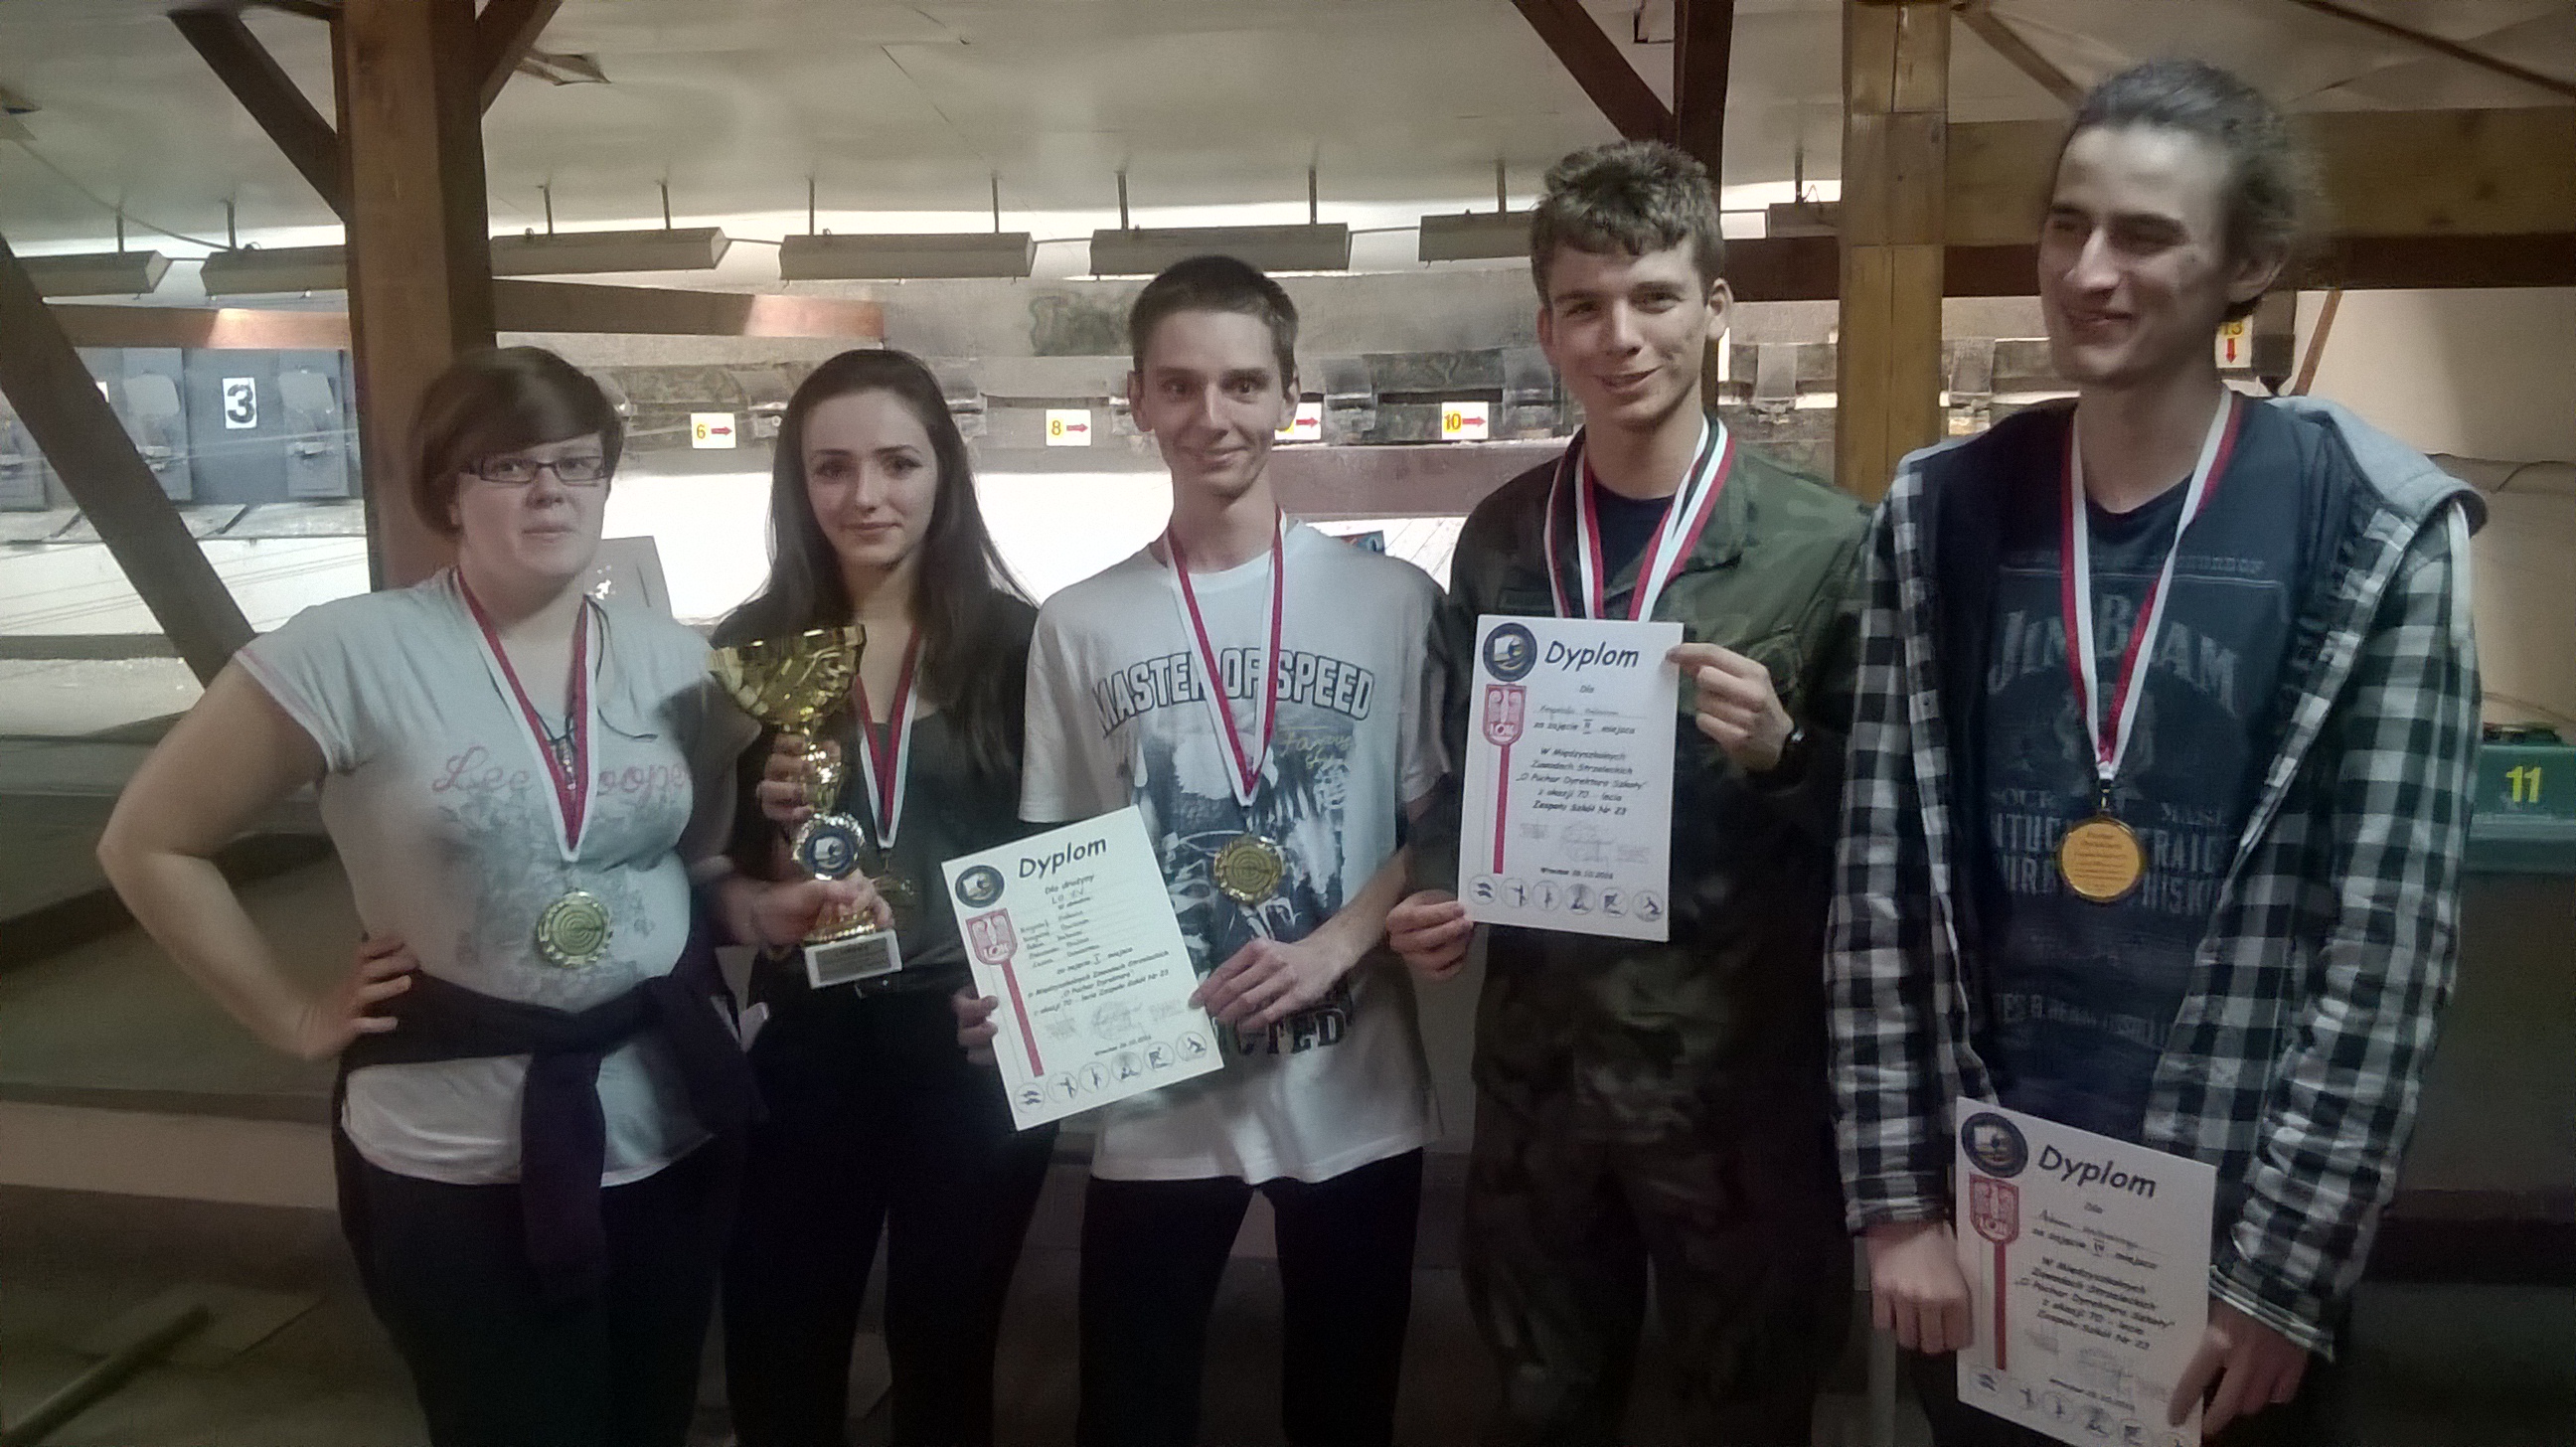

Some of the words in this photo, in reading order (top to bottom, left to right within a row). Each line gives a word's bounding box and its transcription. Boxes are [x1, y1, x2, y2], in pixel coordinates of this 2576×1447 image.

[227, 384, 255, 423] 3
[1444, 412, 1462, 430] 10
[696, 423, 707, 439] 6
[1050, 419, 1061, 435] 8
[1544, 640, 1640, 672] Dyplom
[2095, 592, 2238, 718] BAM
[1219, 647, 1261, 700] OF
[1275, 648, 1375, 722] SPEED
[597, 761, 689, 804] oope
[2505, 765, 2542, 804] 11
[1019, 838, 1107, 880] Dyplom
[2037, 1144, 2157, 1199] Dyplom
